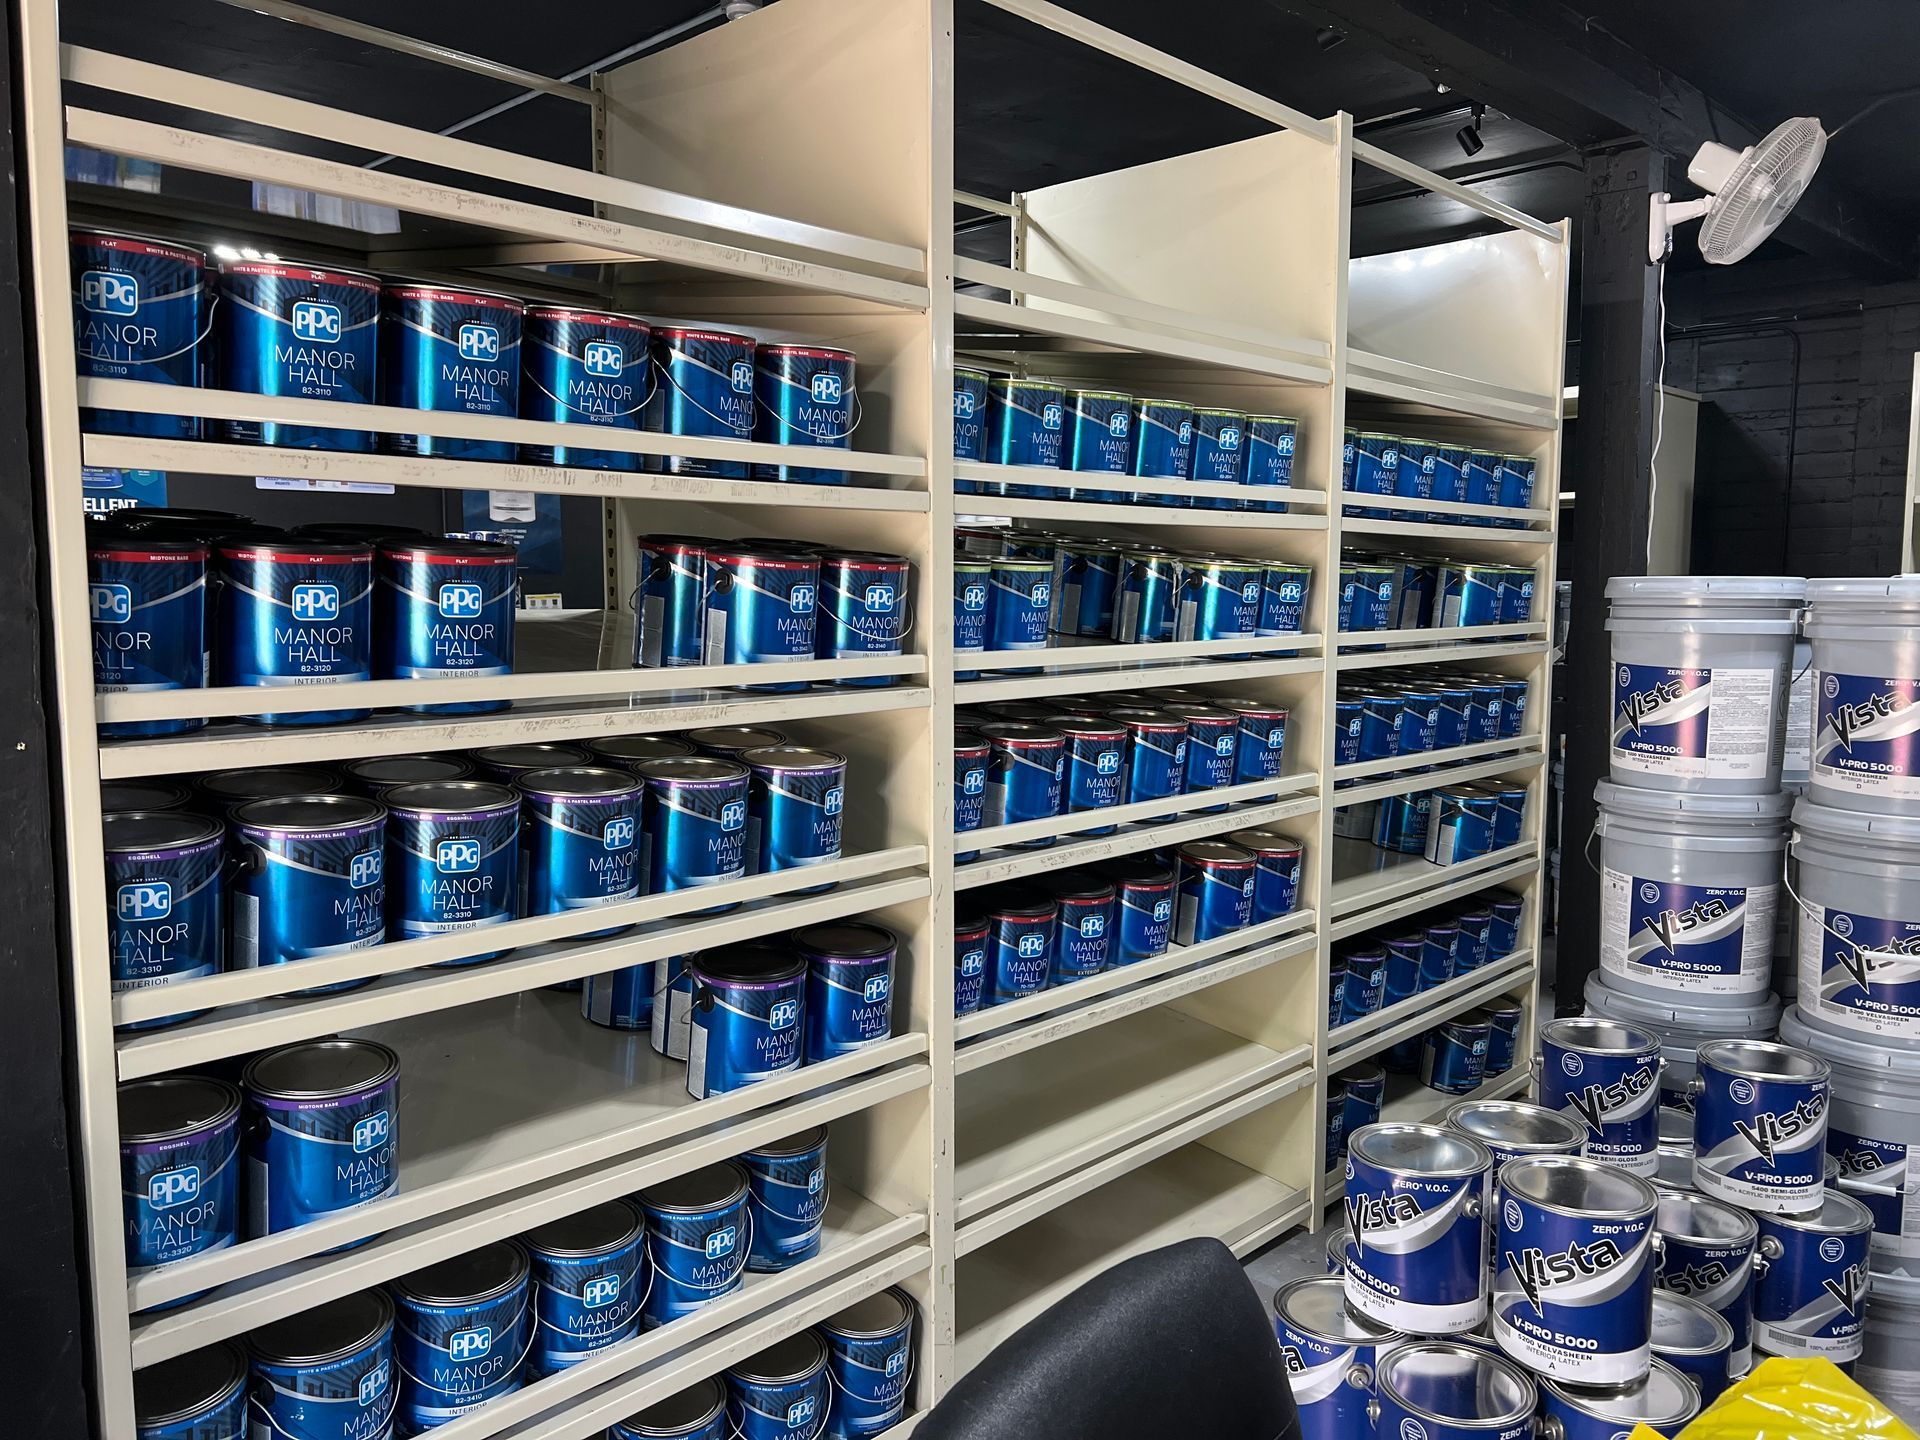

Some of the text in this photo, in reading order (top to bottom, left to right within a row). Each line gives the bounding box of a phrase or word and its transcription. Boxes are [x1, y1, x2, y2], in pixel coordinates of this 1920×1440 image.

[85, 276, 135, 307] PPG
[296, 307, 339, 336] PPG
[462, 329, 497, 357] PPG
[275, 344, 356, 371] MANOR
[92, 363, 128, 375] 82-3110
[289, 365, 343, 388] HALL
[442, 364, 510, 388] MANOR
[301, 386, 332, 396] 82-3110
[455, 383, 500, 403] HALL
[466, 402, 491, 411] 82-3110
[1220, 430, 1238, 447] PPG
[83, 498, 138, 512] ELLENT
[442, 587, 480, 614] PPG
[867, 588, 892, 609] PPG
[1281, 585, 1300, 600] PPG
[295, 589, 336, 617] PPG
[852, 615, 900, 630] MANOR
[1274, 615, 1297, 626] HALL
[275, 627, 353, 645] MANOR
[424, 623, 495, 640] MANOR
[959, 627, 983, 639] HALL
[289, 645, 341, 663] HALL
[435, 640, 484, 657] HALL
[300, 664, 331, 673] 82-3120
[446, 657, 474, 666] 82-3120
[294, 676, 337, 685] INTERIOR
[439, 669, 480, 679] INTERIOR
[1689, 670, 1711, 678] V.O.C.
[1620, 677, 1698, 738] Vista
[1825, 689, 1912, 755] Vista
[1630, 740, 1684, 755] V-PRO 5000
[1098, 753, 1120, 771] PPG
[1637, 752, 1671, 762] VELVASHEEN
[1839, 757, 1904, 773] V-PRO 5000
[1086, 776, 1121, 788] MANOR
[1848, 771, 1889, 781] VELVASHEEN
[1092, 787, 1115, 799] HALL
[606, 819, 633, 846] PPG
[128, 854, 161, 862] EGGSHELL
[439, 844, 478, 869] PPG
[589, 848, 639, 872] MANOR
[352, 856, 380, 882] PPG
[421, 876, 493, 894] MANOR
[120, 887, 168, 917] PPG
[433, 892, 481, 911] HALL
[443, 911, 472, 920] 82-3310
[437, 922, 478, 932] INTERIOR
[1642, 898, 1729, 957] Vista
[1020, 935, 1044, 955] PPG
[112, 943, 175, 966] HALL
[1076, 950, 1102, 962] HALL
[126, 964, 163, 976] 82-3310
[1006, 957, 1048, 974] MANOR
[1660, 958, 1722, 973] V-PRO 5000
[118, 976, 170, 991] INTERIOR
[1013, 971, 1041, 983] HALL
[1662, 973, 1685, 984] INTERIOR
[1670, 971, 1710, 980] VELVASHEEN
[852, 1002, 893, 1022] MANOR
[1854, 998, 1889, 1012] V-PRO
[772, 1001, 796, 1028] PPG
[1866, 1011, 1910, 1023] VELVASHEEN
[756, 1026, 801, 1051] MANOR
[765, 1045, 795, 1063] HALL
[361, 1088, 383, 1100] EGGSHELL
[1565, 1065, 1654, 1138] Vista
[298, 1101, 340, 1110] MIDTONE BASE
[356, 1115, 388, 1147] PPG
[1733, 1093, 1825, 1169] Vista
[159, 1140, 191, 1151] EGGSHELL
[1587, 1141, 1643, 1153] PRO 5000
[1883, 1143, 1906, 1153] V.O.C.
[337, 1141, 396, 1181] MANOR
[350, 1169, 390, 1194] HALL
[1744, 1170, 1814, 1185] V-PRO 5000
[151, 1171, 197, 1204] PPG
[359, 1183, 385, 1199] 82-3320
[1425, 1183, 1451, 1193] V.O.C.
[1770, 1186, 1809, 1195] SEMI-GLOSS
[1777, 1203, 1785, 1211] A
[129, 1200, 216, 1237] MANOR
[1344, 1189, 1424, 1260] Vista
[144, 1225, 202, 1253] HALL
[157, 1245, 193, 1261] 82-3320
[1346, 1254, 1401, 1297] V-PRO 5000
[1505, 1238, 1624, 1320] Vista
[1653, 1260, 1730, 1297] ista
[586, 1277, 619, 1304] PPG
[1357, 1280, 1396, 1306] VELVASHEEN
[1361, 1300, 1368, 1309] A
[569, 1300, 629, 1329] MANOR
[1513, 1313, 1599, 1351] V-PRO 5000
[1831, 1324, 1858, 1336] V-PRO
[452, 1328, 489, 1358] PPG
[1307, 1341, 1333, 1356] V.O.C.
[1517, 1333, 1593, 1361] 5200 VELVASHEEN
[1525, 1345, 1582, 1367] INTERIOR LATEX
[434, 1355, 503, 1384] MANOR
[1548, 1360, 1557, 1370] A
[456, 1392, 483, 1405] 82-3410
[449, 1402, 489, 1416] INTERIOR
